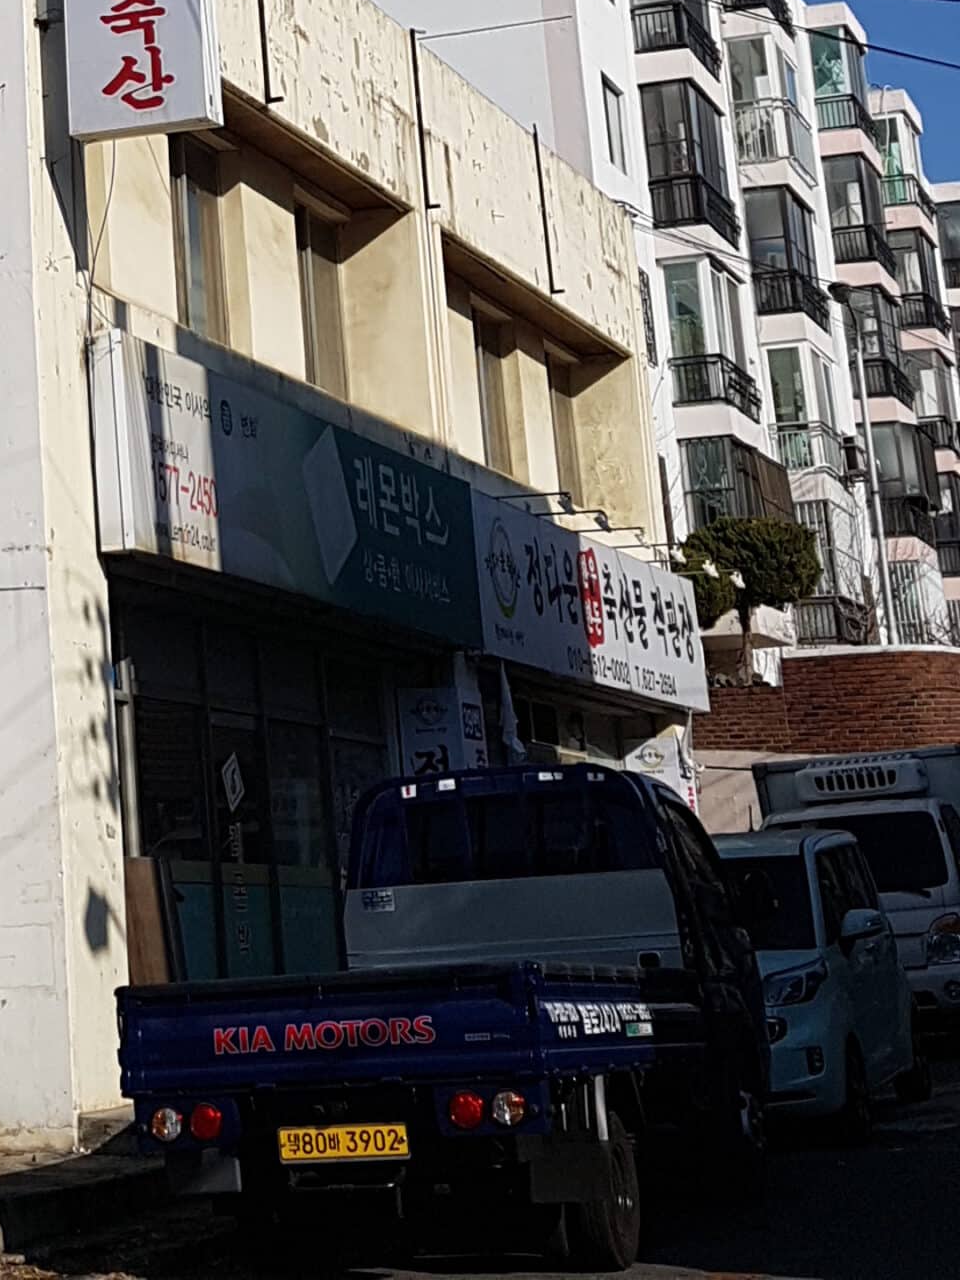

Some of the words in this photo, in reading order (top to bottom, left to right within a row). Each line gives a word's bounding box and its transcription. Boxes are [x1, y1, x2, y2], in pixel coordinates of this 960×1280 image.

[353, 455, 449, 547] 레몬박스
[525, 536, 578, 625] 정다운
[602, 563, 649, 650] 축산물
[649, 586, 694, 664] 직판장
[214, 1026, 273, 1054] KIA
[285, 1015, 436, 1052] MOTORS
[345, 1129, 401, 1153] 3902
